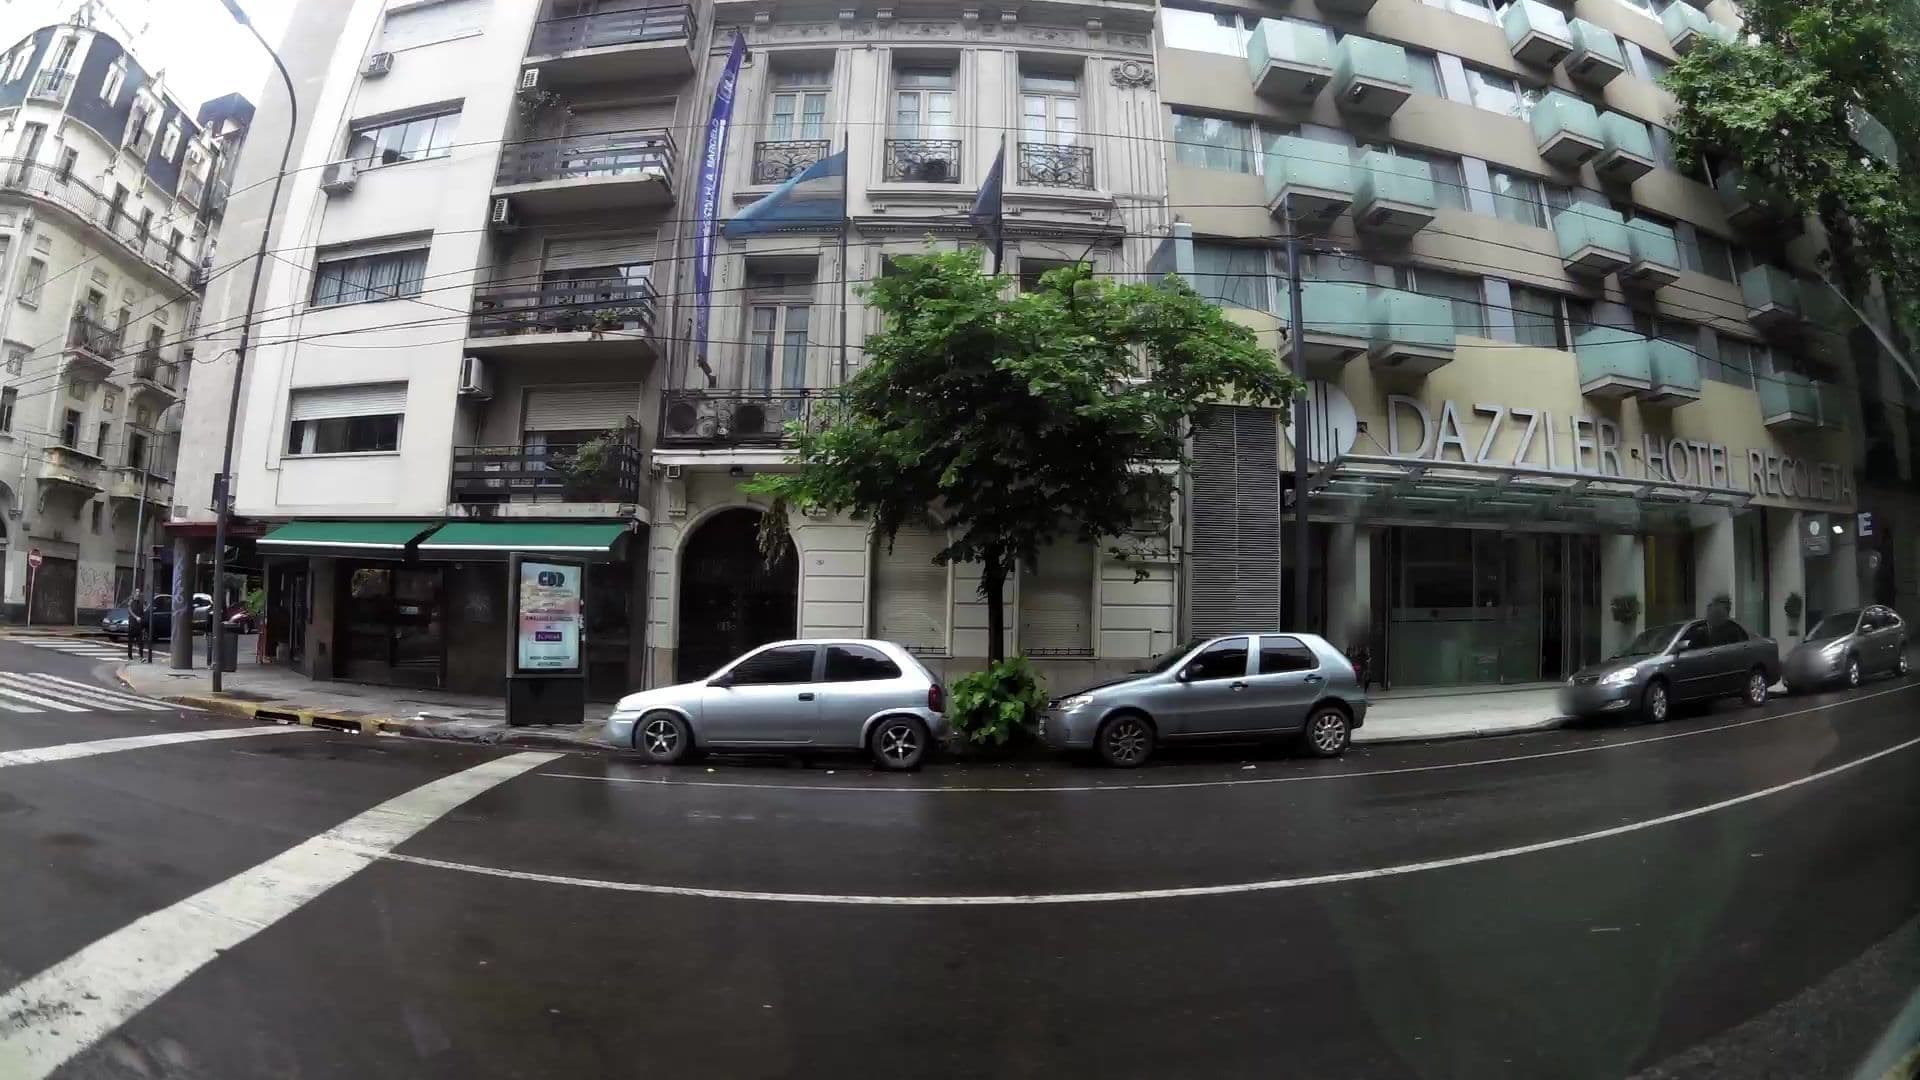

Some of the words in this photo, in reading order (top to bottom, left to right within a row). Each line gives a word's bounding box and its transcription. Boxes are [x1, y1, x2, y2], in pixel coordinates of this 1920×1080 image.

[1387, 393, 1623, 476] DAZZLER
[1641, 433, 1735, 489] HOTEL
[1747, 448, 1858, 502] RECOLETA
